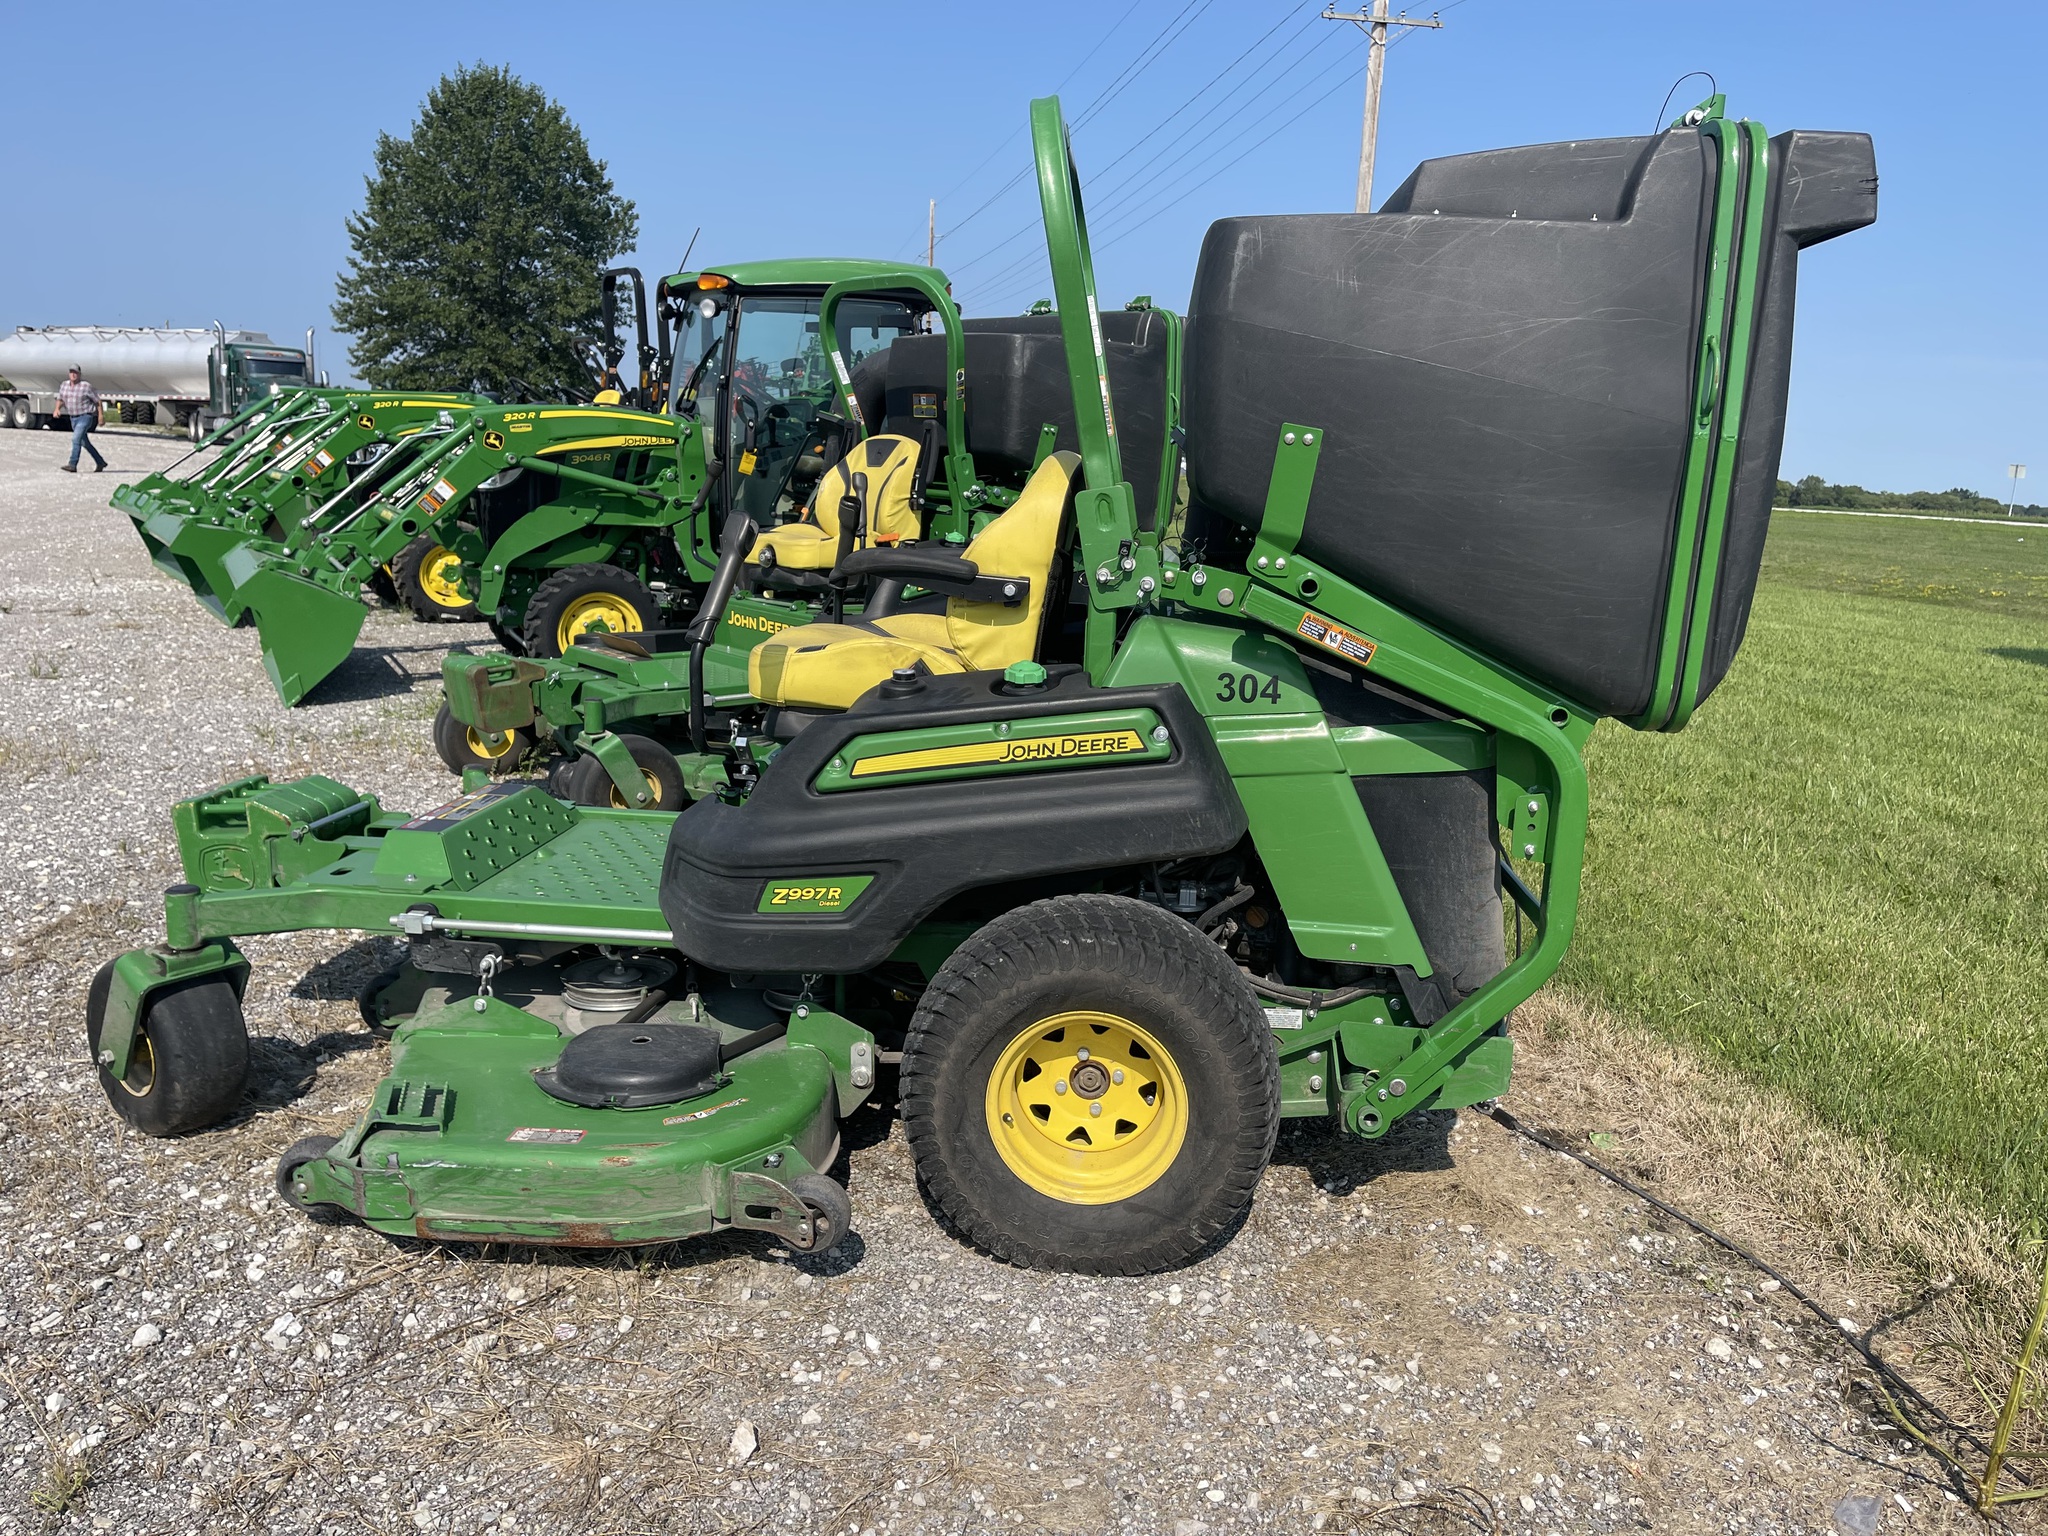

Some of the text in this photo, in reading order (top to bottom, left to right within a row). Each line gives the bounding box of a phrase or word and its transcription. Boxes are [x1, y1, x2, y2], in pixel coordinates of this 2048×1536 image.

[621, 437, 675, 446] JOHN DEE
[727, 610, 794, 634] JOHN DEE
[1216, 672, 1281, 704] 304
[999, 737, 1129, 761] JOHN DEERE
[1118, 985, 1213, 1065] KENDA
